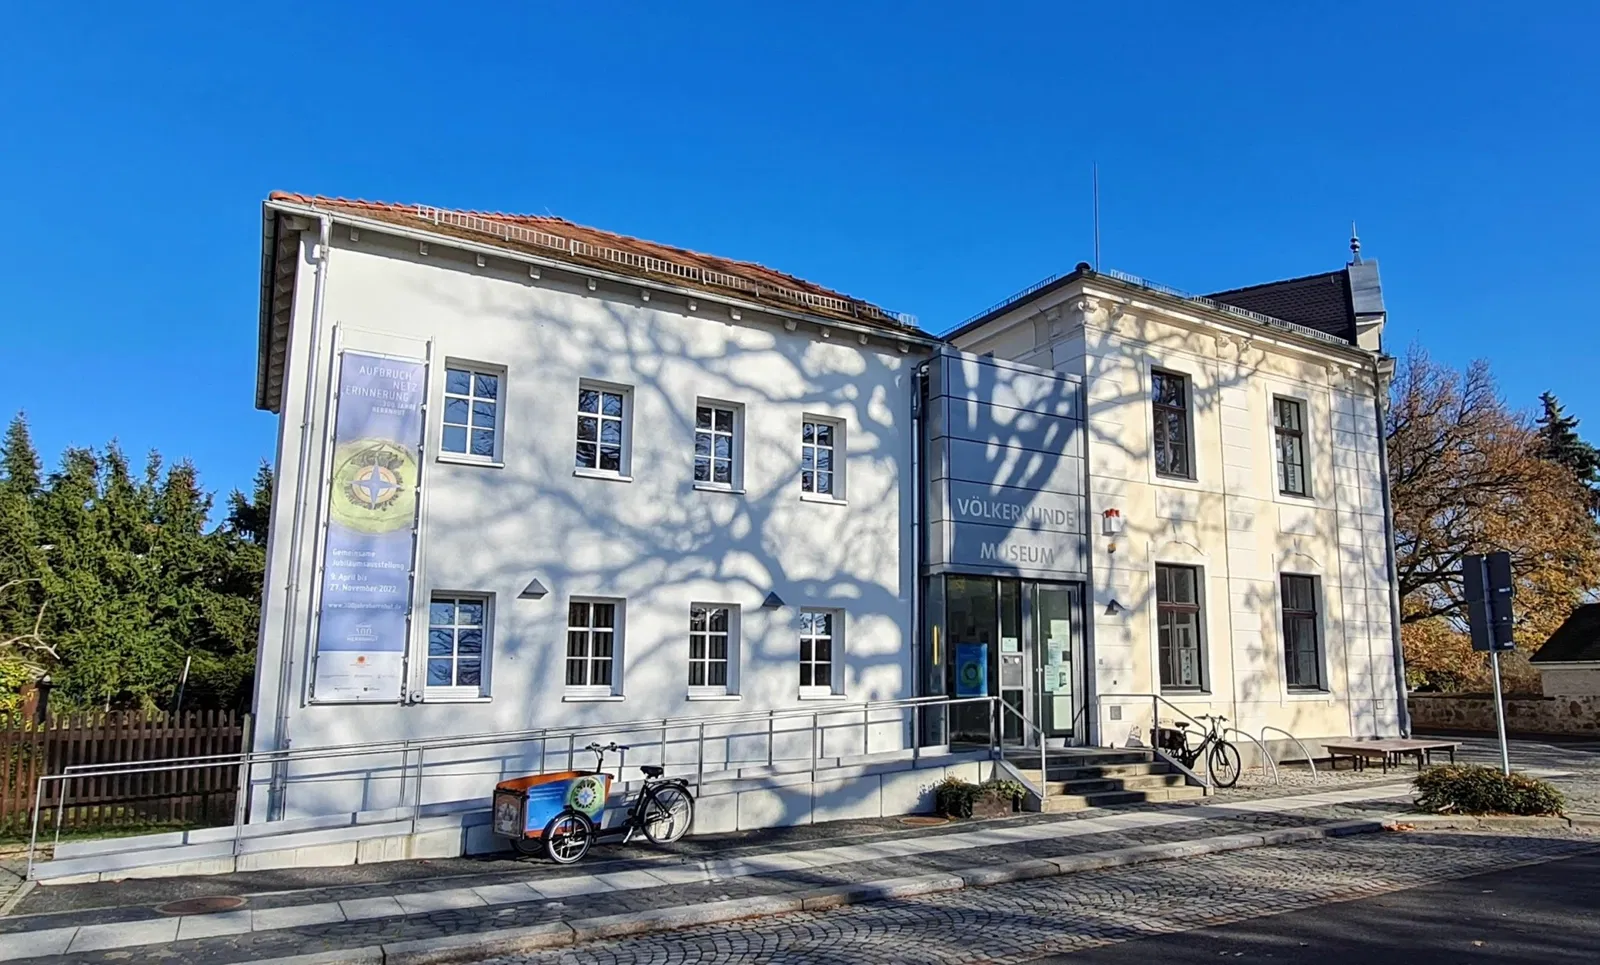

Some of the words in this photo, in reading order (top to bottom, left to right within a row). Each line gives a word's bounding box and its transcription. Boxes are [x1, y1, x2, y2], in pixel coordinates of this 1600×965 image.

[359, 365, 412, 380] AUFBRUCH
[392, 380, 418, 392] NETZ
[345, 385, 409, 402] ERINNERUNG
[957, 495, 1075, 528] VÖLKERKUNDE
[332, 548, 376, 557] Gemeinsame
[980, 542, 1055, 565] MUSEUM
[331, 559, 405, 571] Jubiläumsausstellung
[338, 573, 356, 582] April
[357, 573, 367, 582] bis
[342, 584, 379, 592] November
[379, 585, 397, 593] 2022
